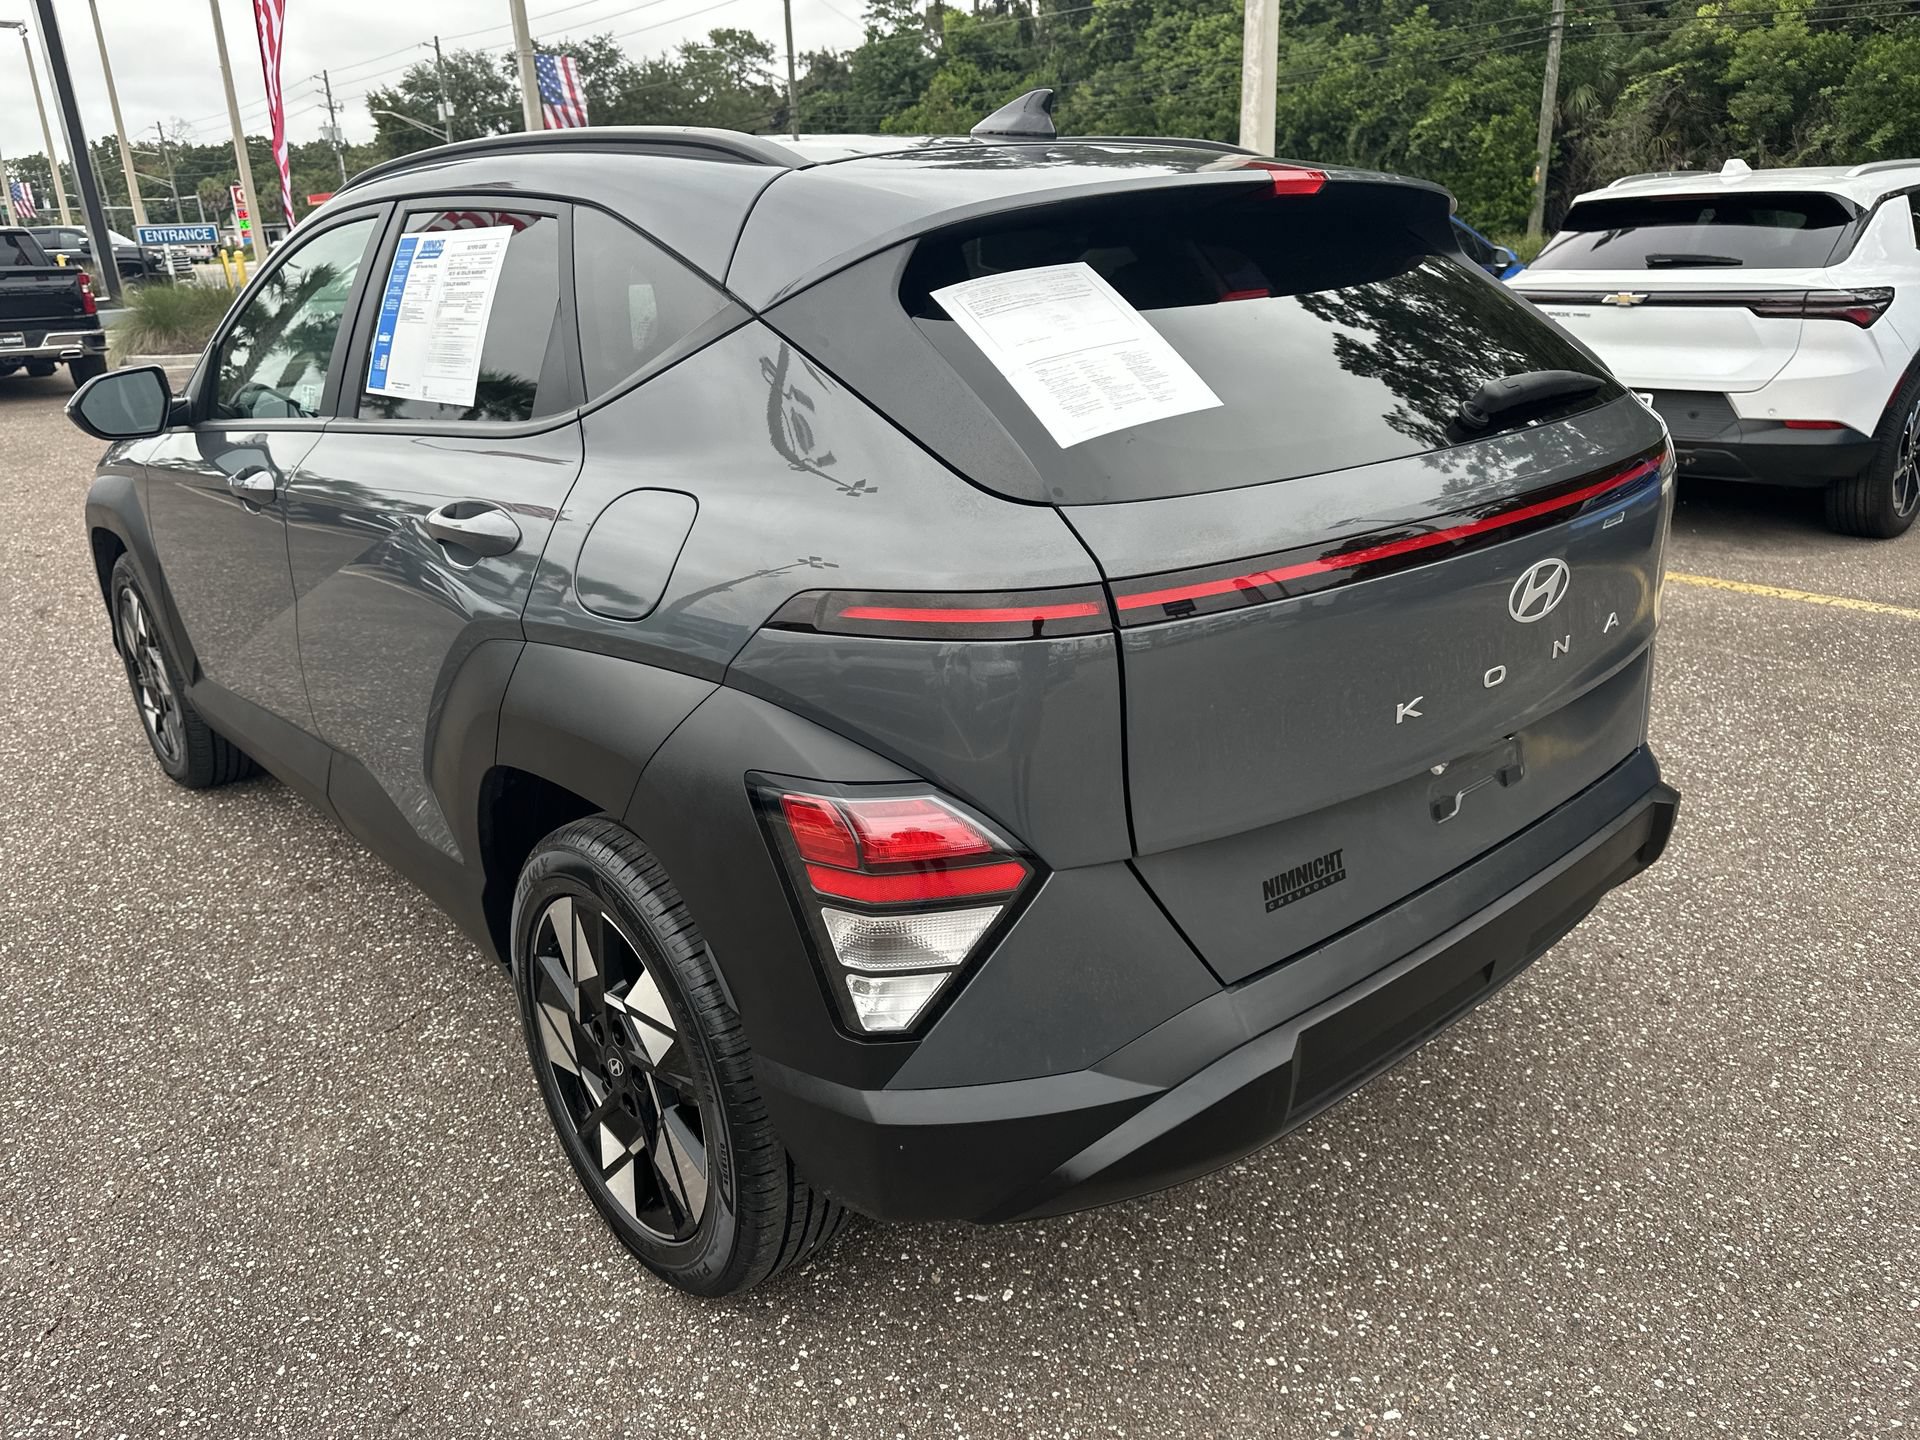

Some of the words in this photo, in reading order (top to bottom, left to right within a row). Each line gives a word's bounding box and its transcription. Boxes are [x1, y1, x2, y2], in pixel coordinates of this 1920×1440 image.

[144, 228, 212, 242] ENTRANCE
[1396, 612, 1620, 725] KONA
[1262, 848, 1343, 901] NIMNICHT
[1266, 870, 1345, 911] CHEVROLET
